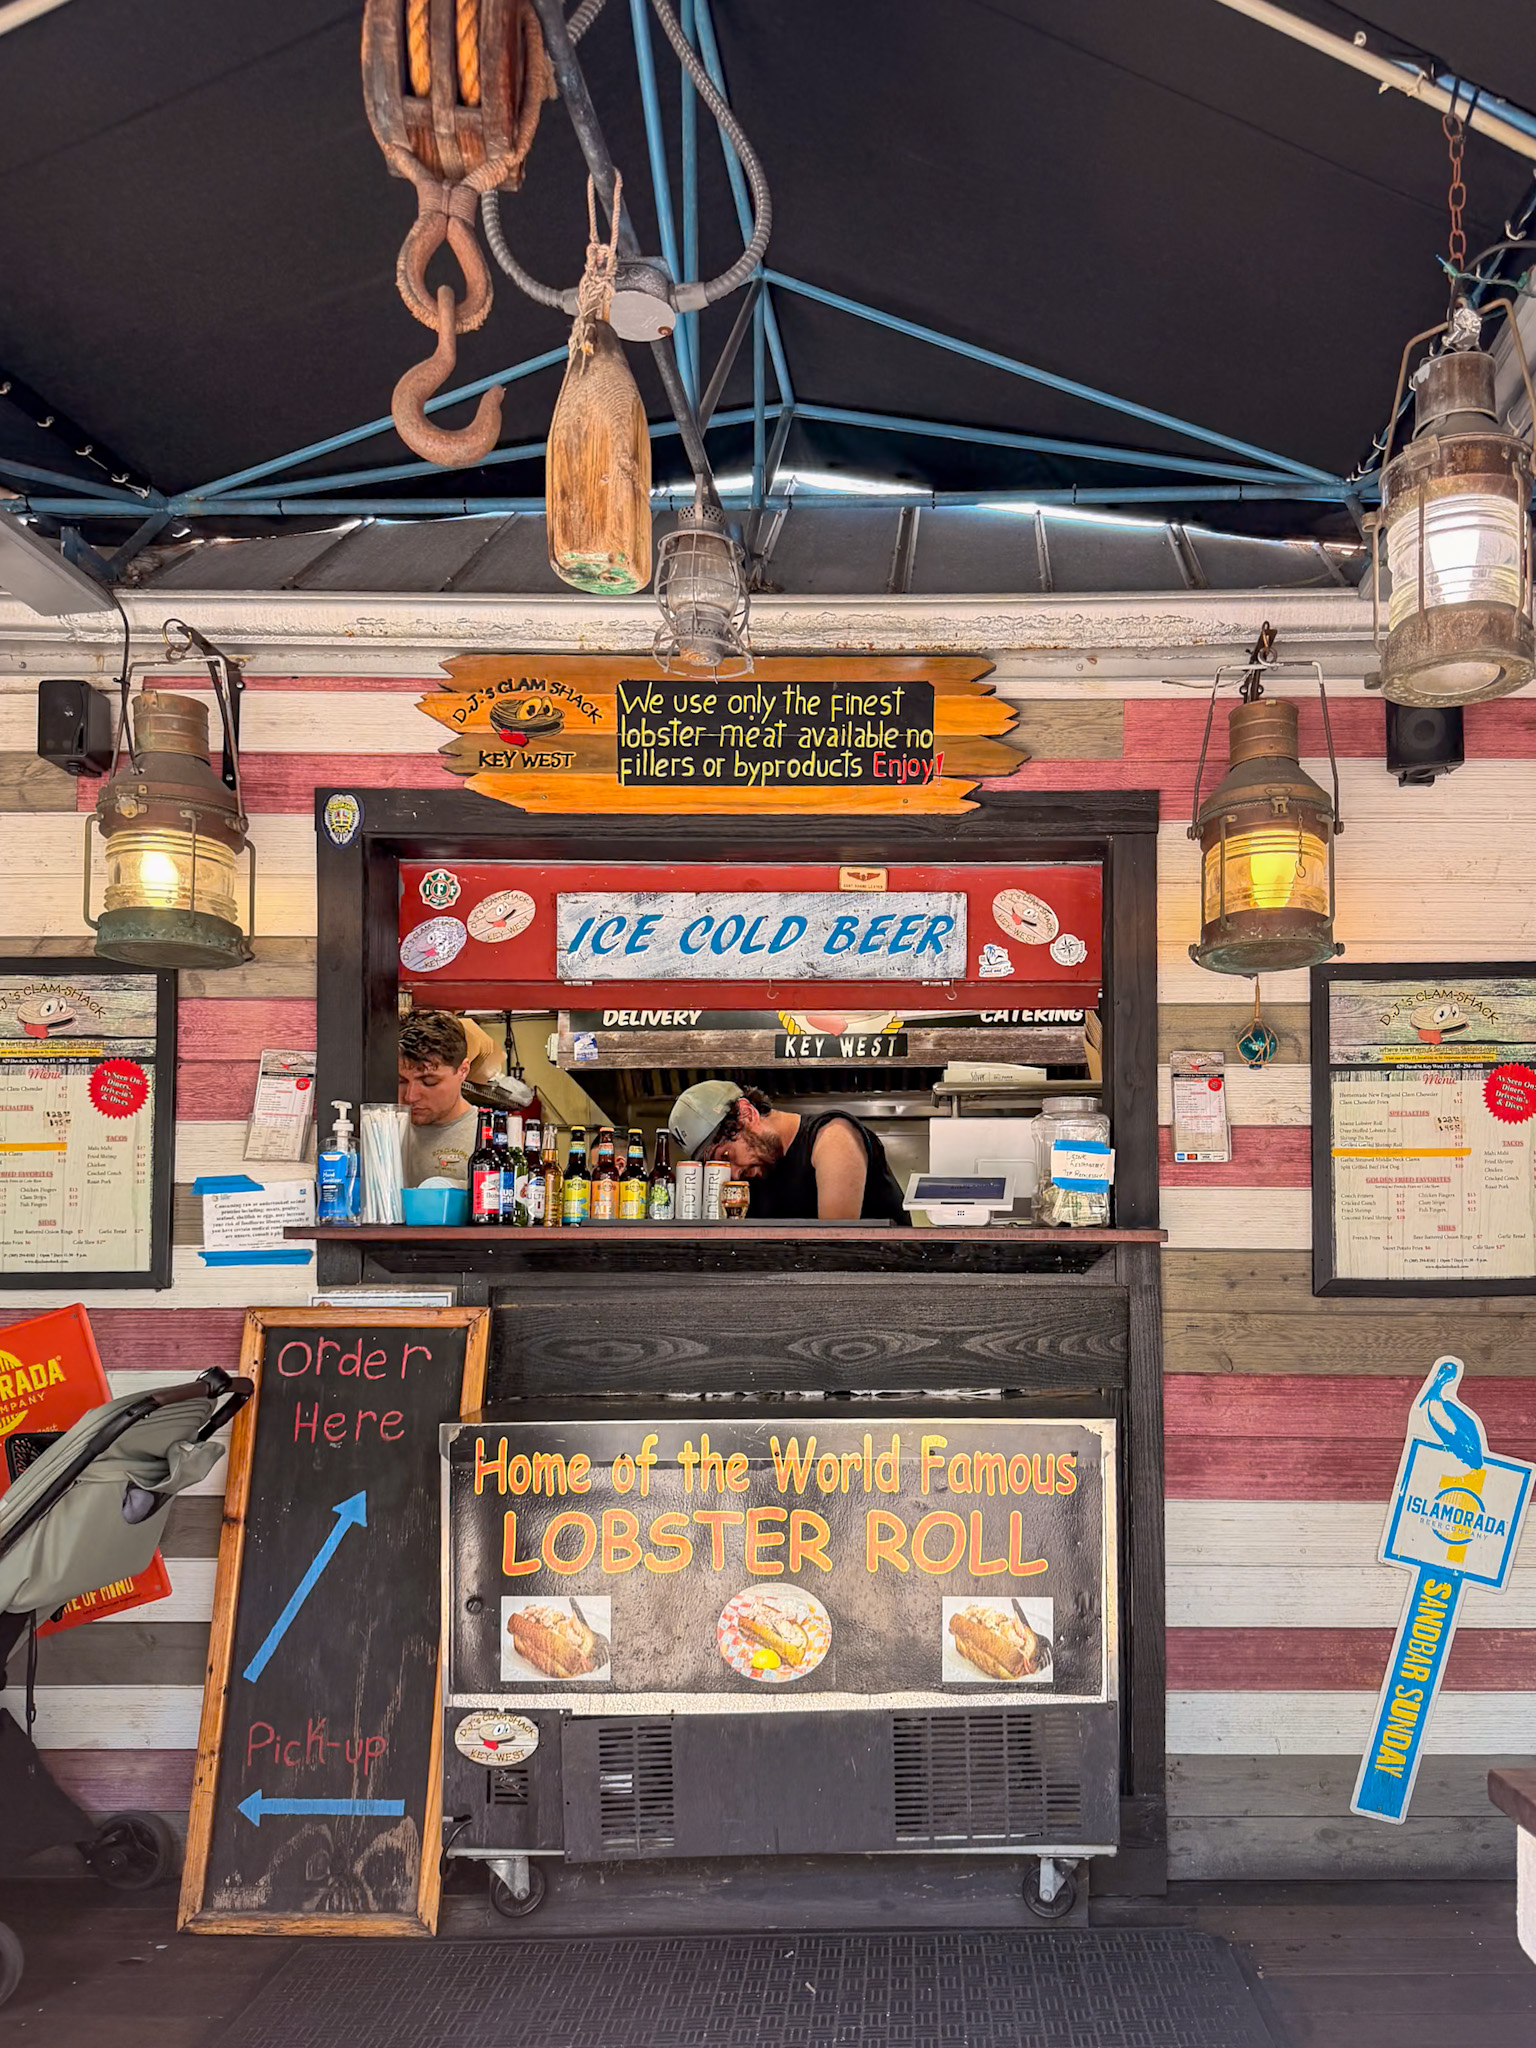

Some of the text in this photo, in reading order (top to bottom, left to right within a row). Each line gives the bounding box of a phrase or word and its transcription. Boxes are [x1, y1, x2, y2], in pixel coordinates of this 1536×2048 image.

[497, 677, 547, 693] CLAM
[549, 682, 604, 725] SHACK
[618, 682, 664, 714] We
[673, 694, 717, 714] use
[728, 684, 776, 724] only
[782, 684, 821, 715] the
[621, 714, 934, 749] lobster meat available no
[478, 750, 576, 768] KEY WEST
[703, 758, 726, 777] or
[734, 750, 863, 786] byproducts
[873, 751, 944, 786] Enjoy!
[503, 893, 529, 904] SHACK
[487, 916, 531, 941] KEY WEST
[568, 913, 956, 957] ICE COLD BEER
[997, 914, 1036, 943] KEY WEST
[1039, 908, 1055, 935] SHACK
[23, 983, 61, 996] CLAM
[64, 986, 106, 1019] SHACK
[1415, 988, 1453, 1002] CLAM
[1457, 991, 1499, 1025] SHACK
[602, 1010, 702, 1027] DELIVERY
[980, 1009, 1084, 1024] CATERING
[784, 1036, 897, 1058] KEY WEST
[27, 1067, 62, 1079] Menu
[113, 1072, 128, 1081] Seen
[1423, 1074, 1456, 1085] Menu
[1507, 1077, 1522, 1087] Seen
[1505, 1101, 1524, 1111] Dives
[594, 1203, 611, 1214] ALE
[278, 1336, 432, 1380] Order
[294, 1402, 405, 1443] Here
[474, 1433, 1078, 1497] Home of the World Famous
[1406, 1494, 1506, 1537] ISLAMORADA
[1420, 1517, 1488, 1541] BEER COMPANY
[502, 1506, 1049, 1577] LOBSTER ROLL
[1374, 1578, 1453, 1779] SANDBAR SUNDAY
[482, 1713, 507, 1722] CLAM
[508, 1716, 537, 1738] SHACK
[247, 1718, 386, 1776] Pick-up
[470, 1749, 525, 1761] KEY WEST
